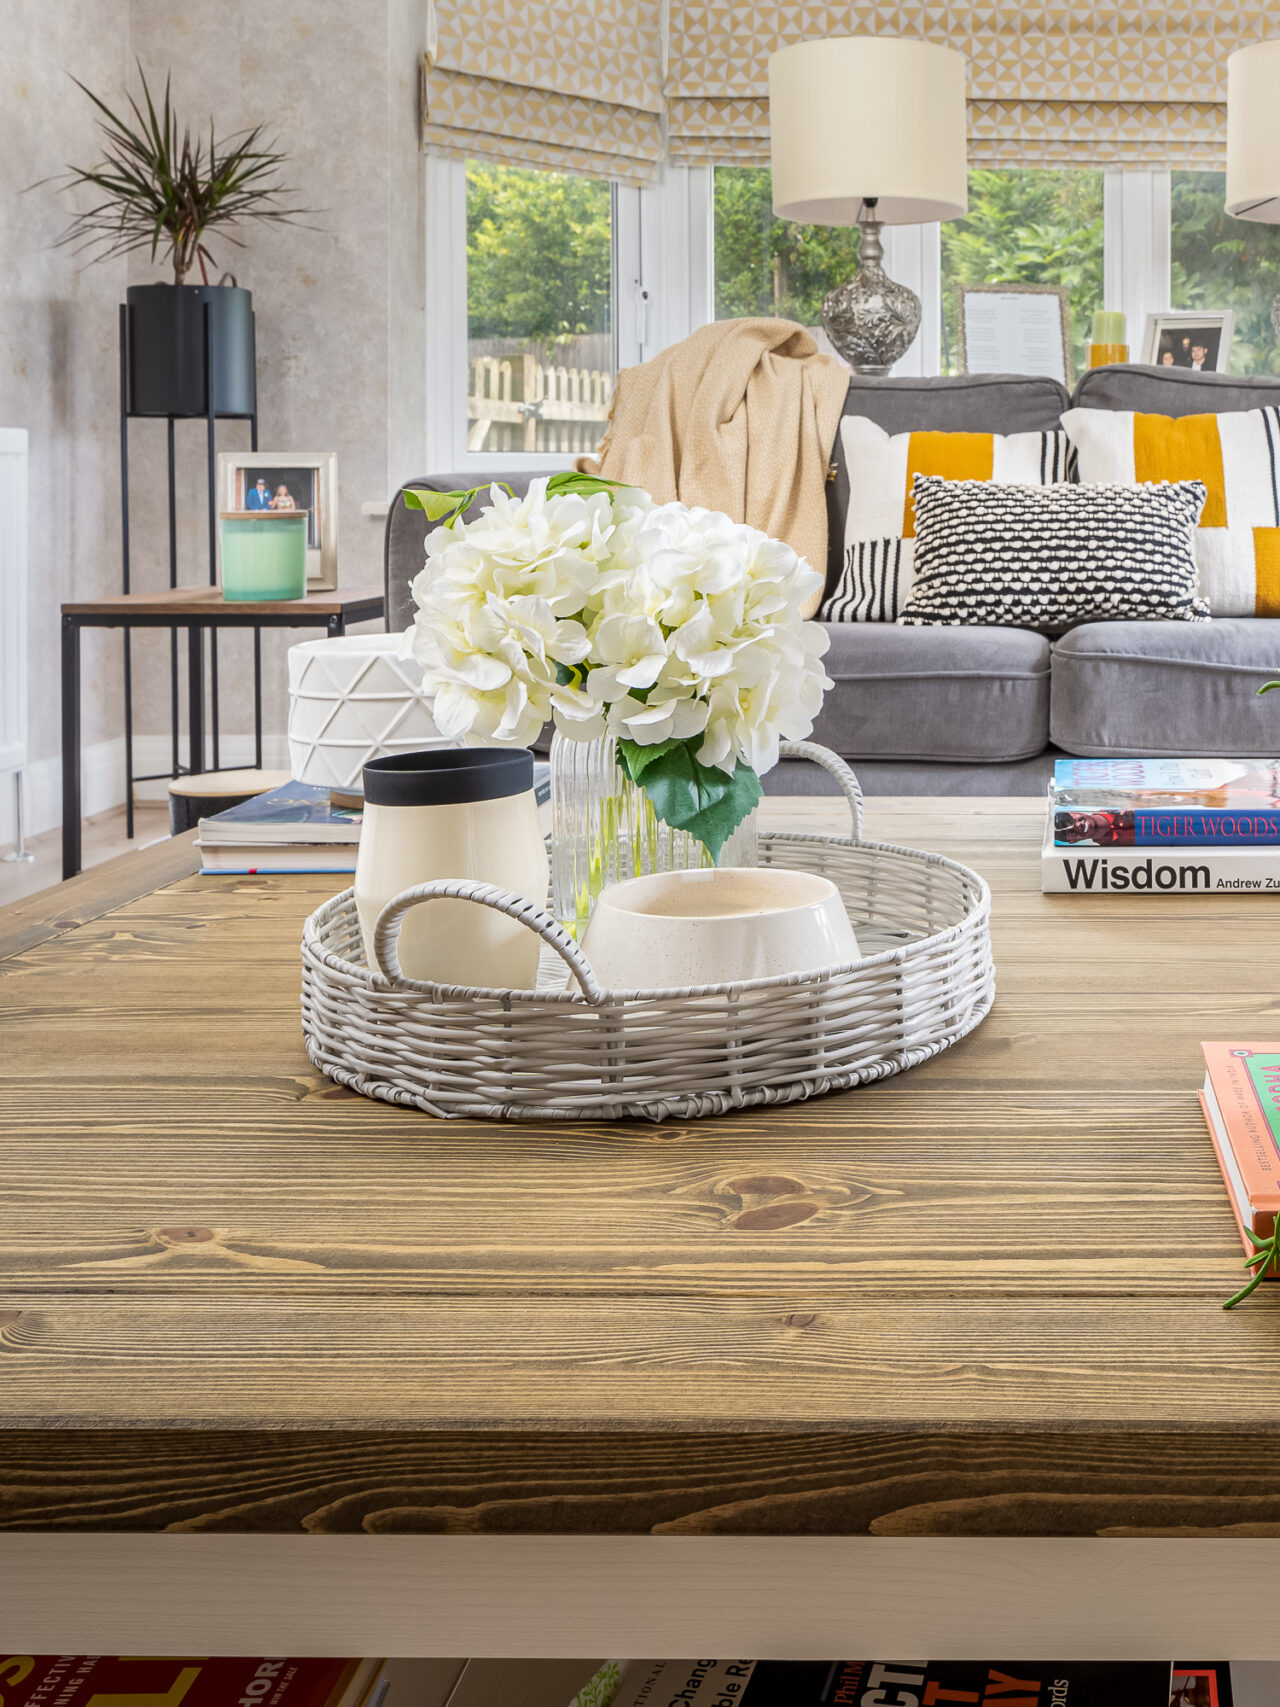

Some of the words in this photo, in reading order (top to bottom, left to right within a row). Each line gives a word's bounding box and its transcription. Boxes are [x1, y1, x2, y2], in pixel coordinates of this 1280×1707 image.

[1137, 816, 1196, 837] TIGER
[1201, 816, 1278, 837] WOODS
[1063, 859, 1211, 889] Wisdom
[1216, 878, 1261, 889] Andrew
[833, 1675, 860, 1704] Phil
